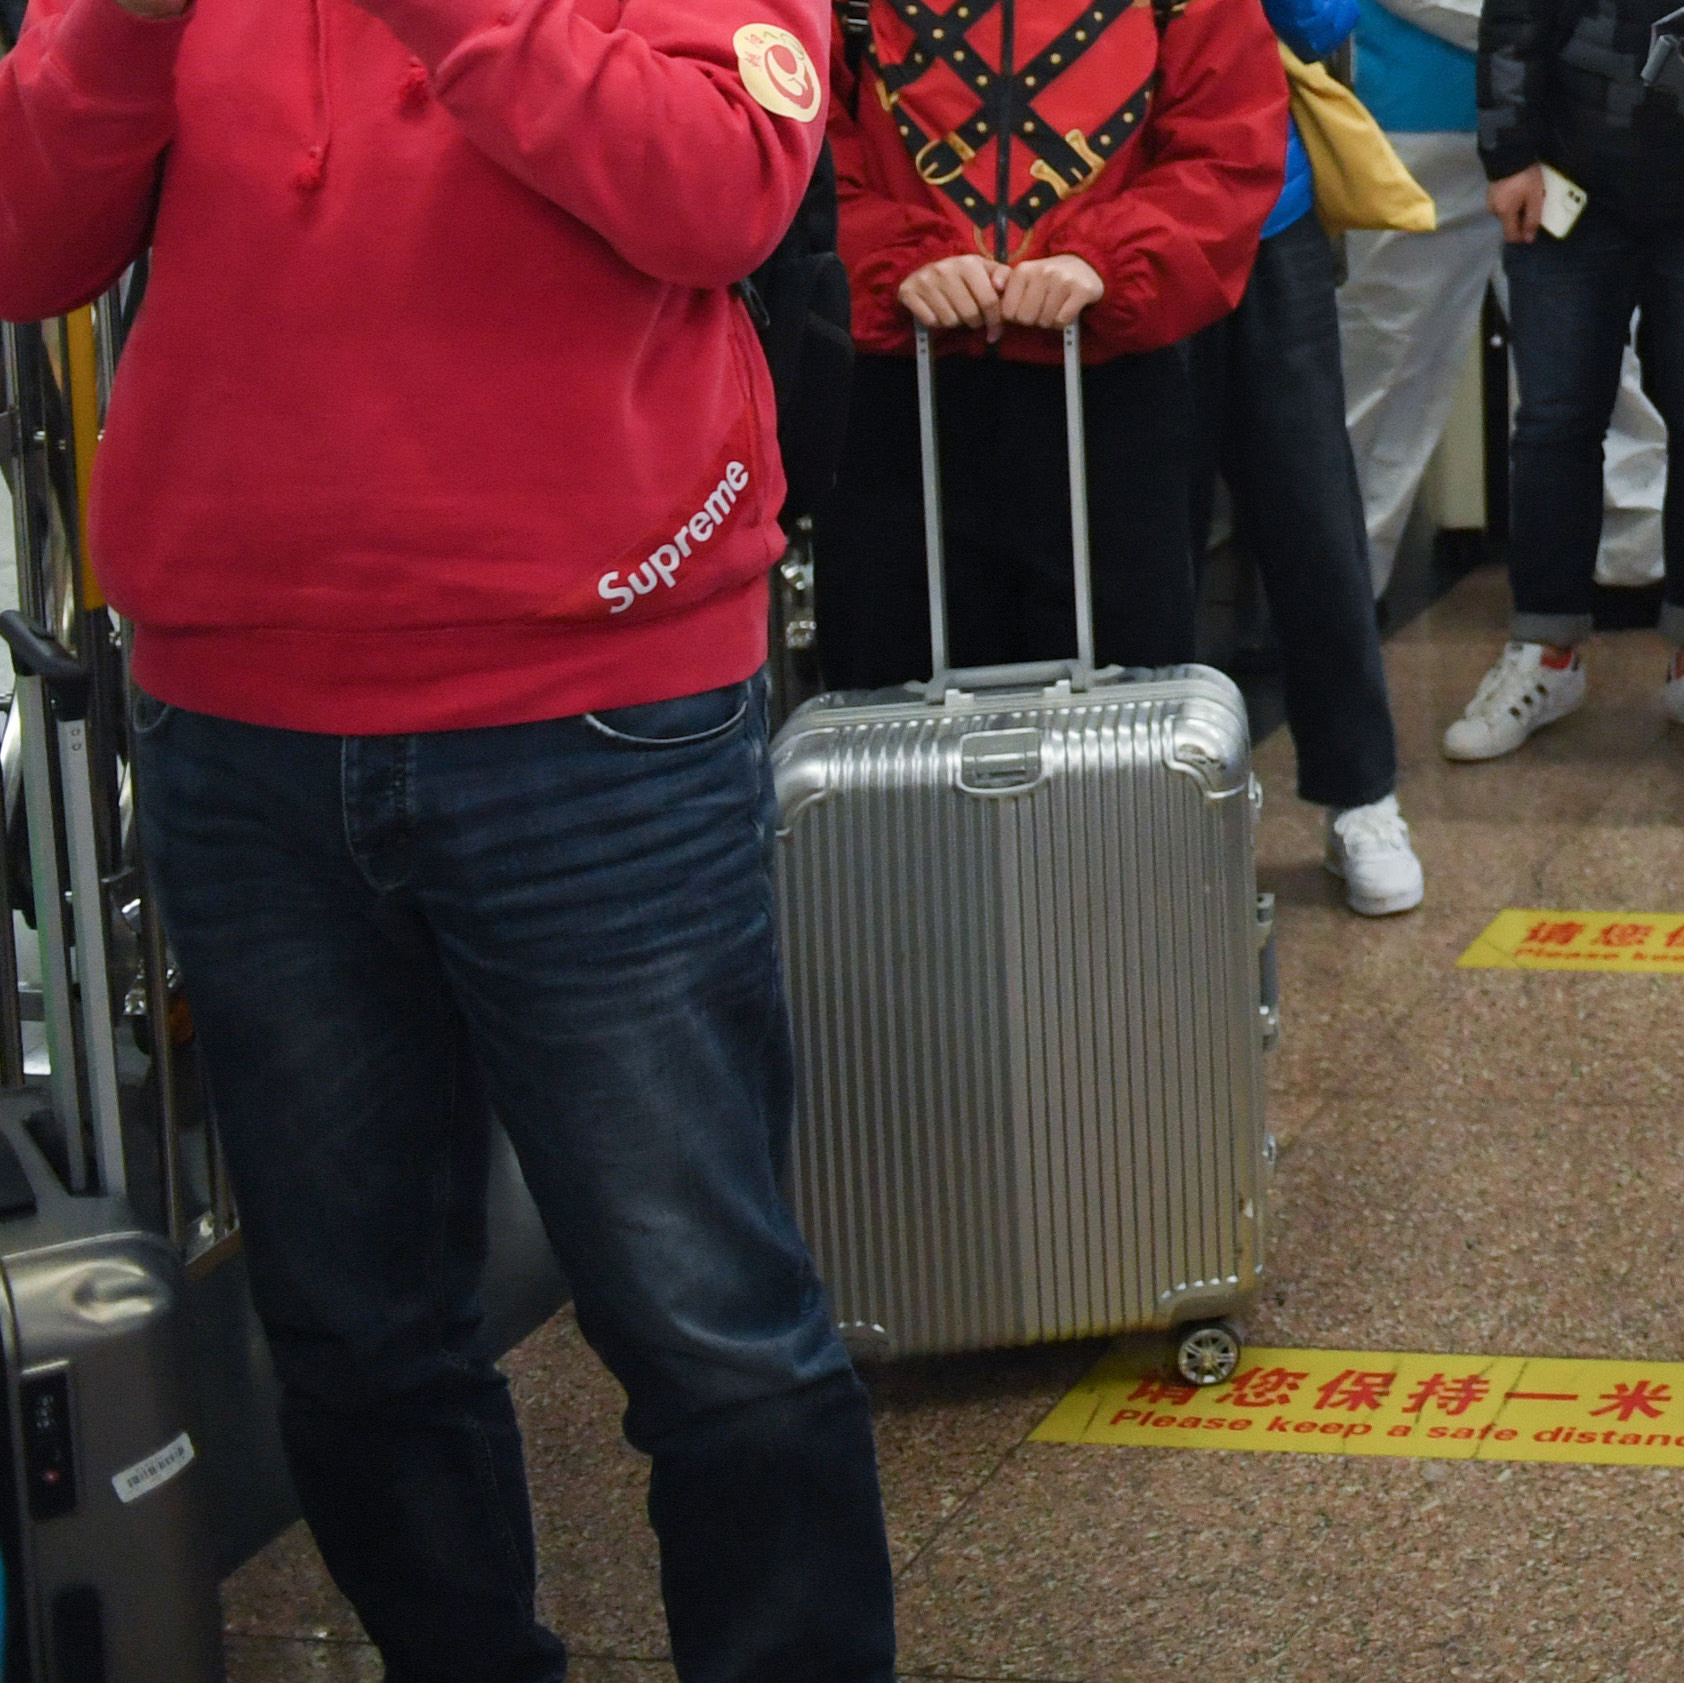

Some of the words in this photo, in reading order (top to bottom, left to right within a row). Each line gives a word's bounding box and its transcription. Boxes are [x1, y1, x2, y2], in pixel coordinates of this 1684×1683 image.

[597, 460, 749, 614] Supreme
[1109, 1408, 1253, 1431] Please
[1266, 1416, 1373, 1439] keep
[1387, 1424, 1413, 1439] a
[1427, 1423, 1518, 1442] safe
